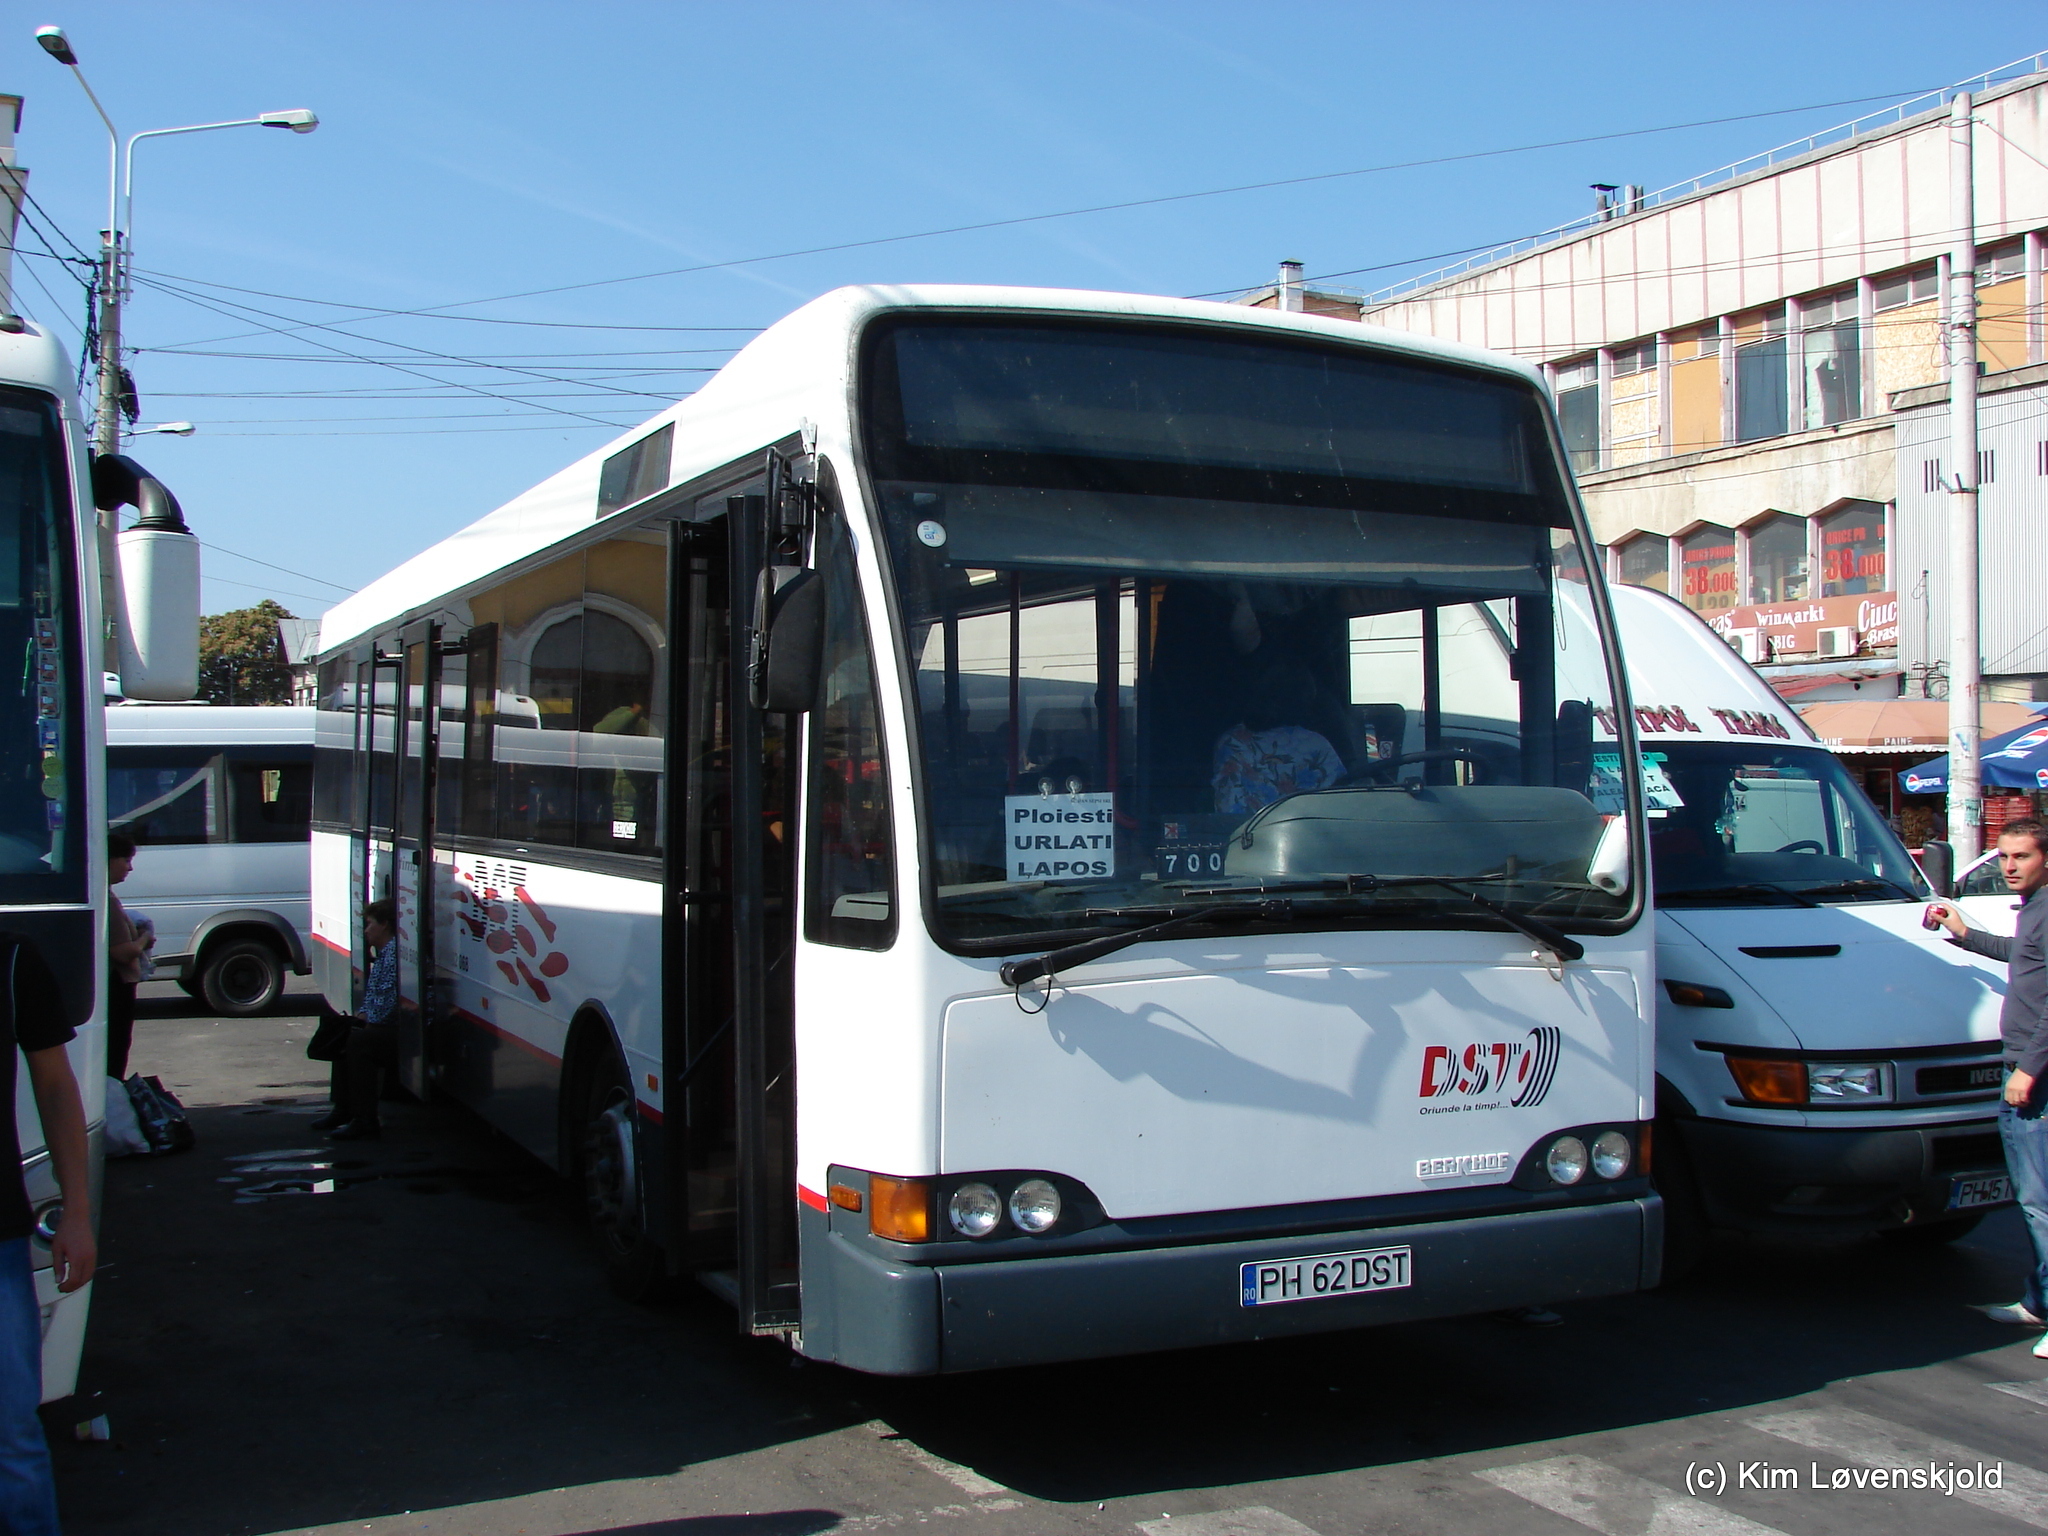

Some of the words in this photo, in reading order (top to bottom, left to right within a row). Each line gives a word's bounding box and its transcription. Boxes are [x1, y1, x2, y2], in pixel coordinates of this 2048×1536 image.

[1774, 634, 1795, 649] BIG
[1014, 808, 1113, 824] Ploiesti
[1014, 834, 1112, 850] URLATI
[1419, 1104, 1461, 1116] Oriunde
[1462, 1103, 1473, 1112] la
[1416, 1152, 1510, 1181] BERKHOF
[1260, 1265, 1301, 1299] PH
